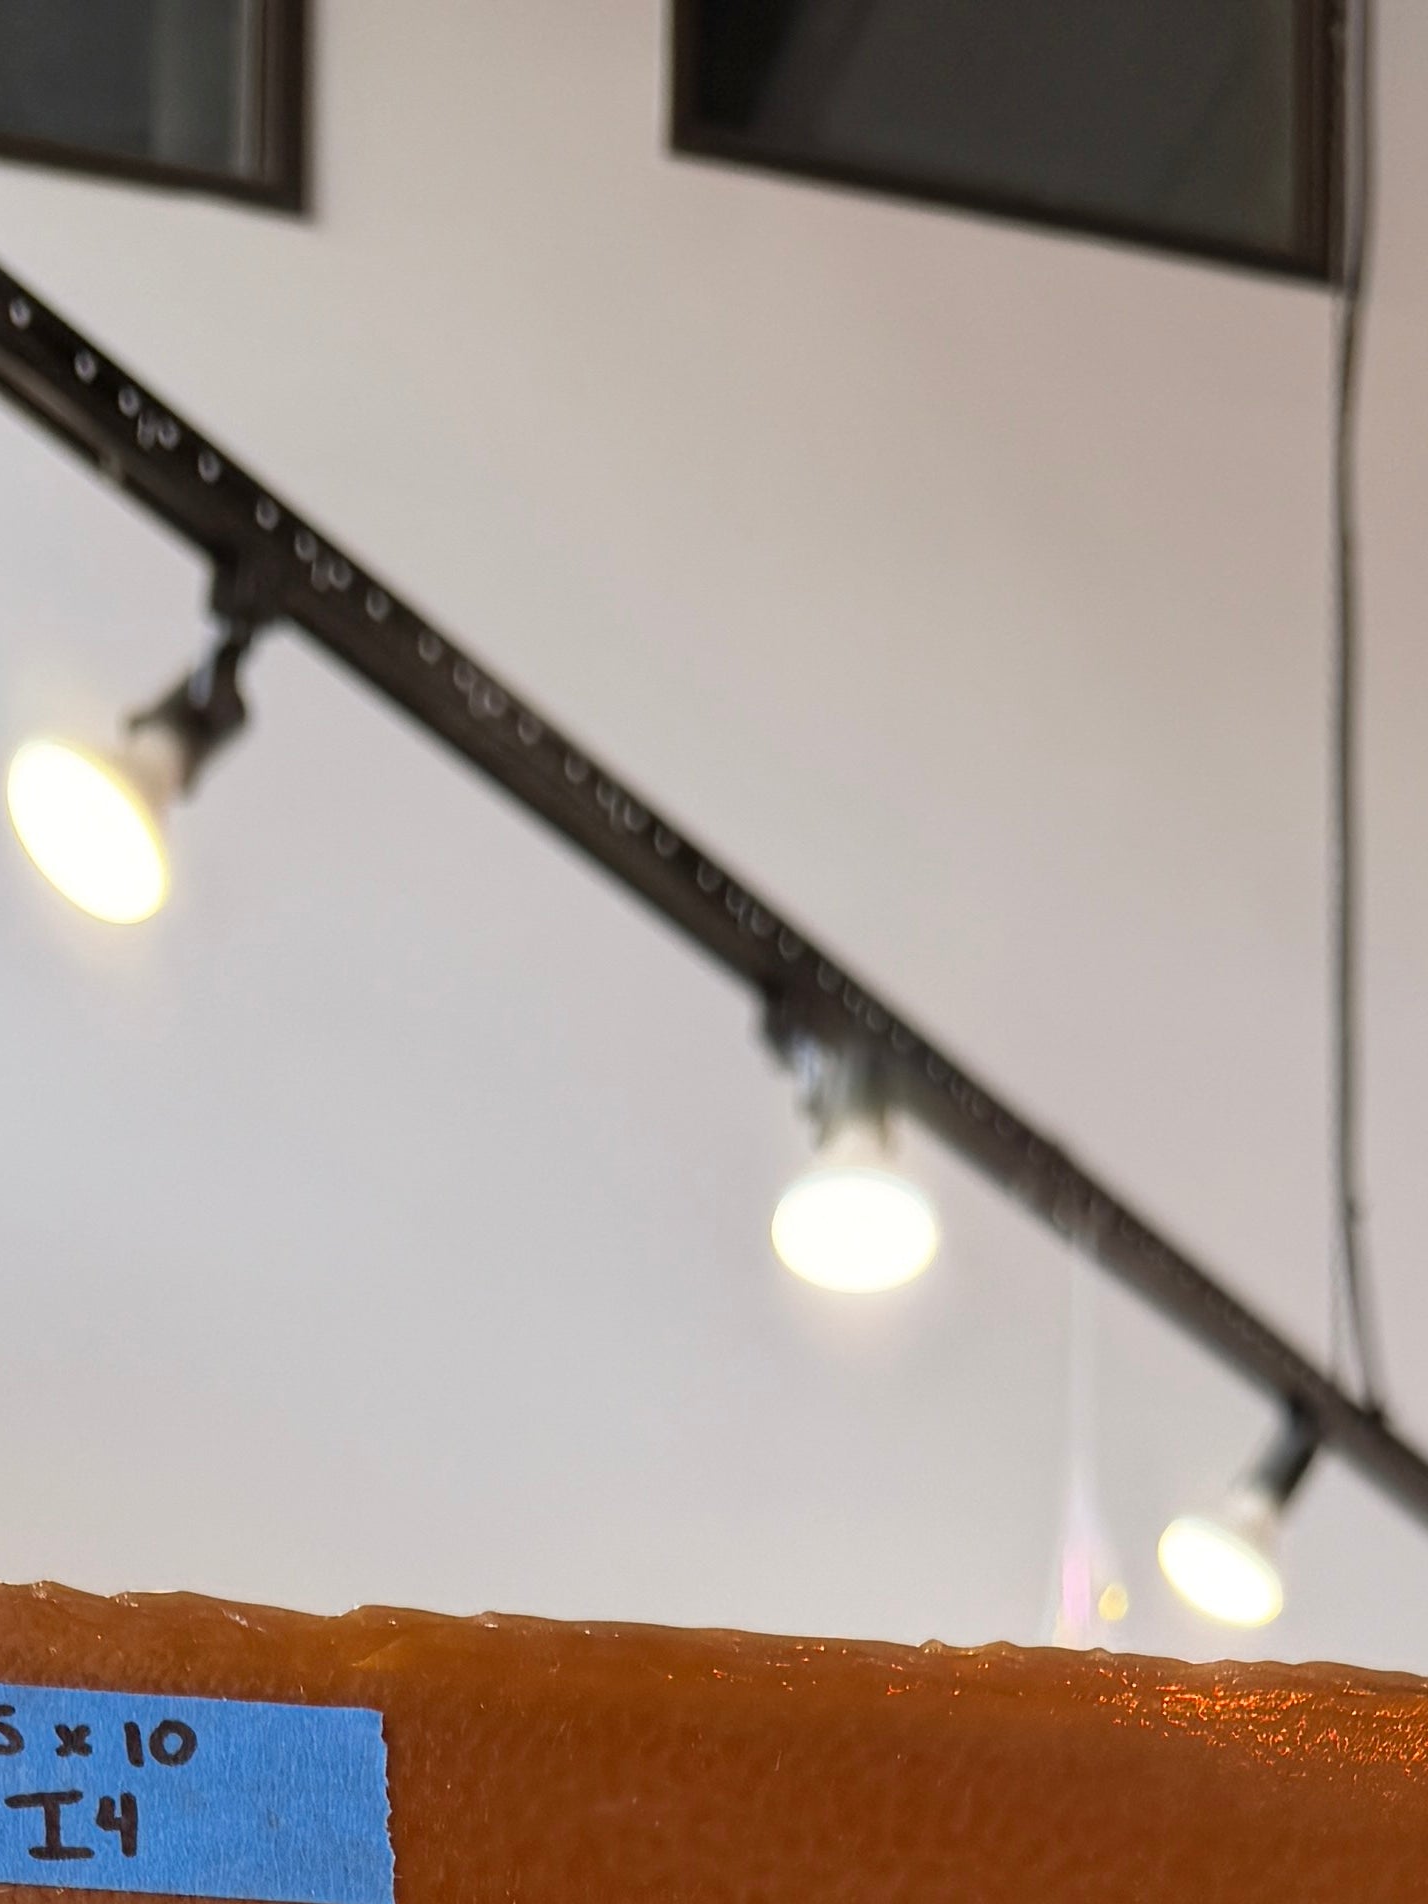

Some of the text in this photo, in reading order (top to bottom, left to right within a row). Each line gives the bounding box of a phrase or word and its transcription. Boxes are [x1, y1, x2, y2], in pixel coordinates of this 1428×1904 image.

[53, 1723, 94, 1758] x
[122, 1718, 198, 1768] 10
[3, 1789, 140, 1861] I4
